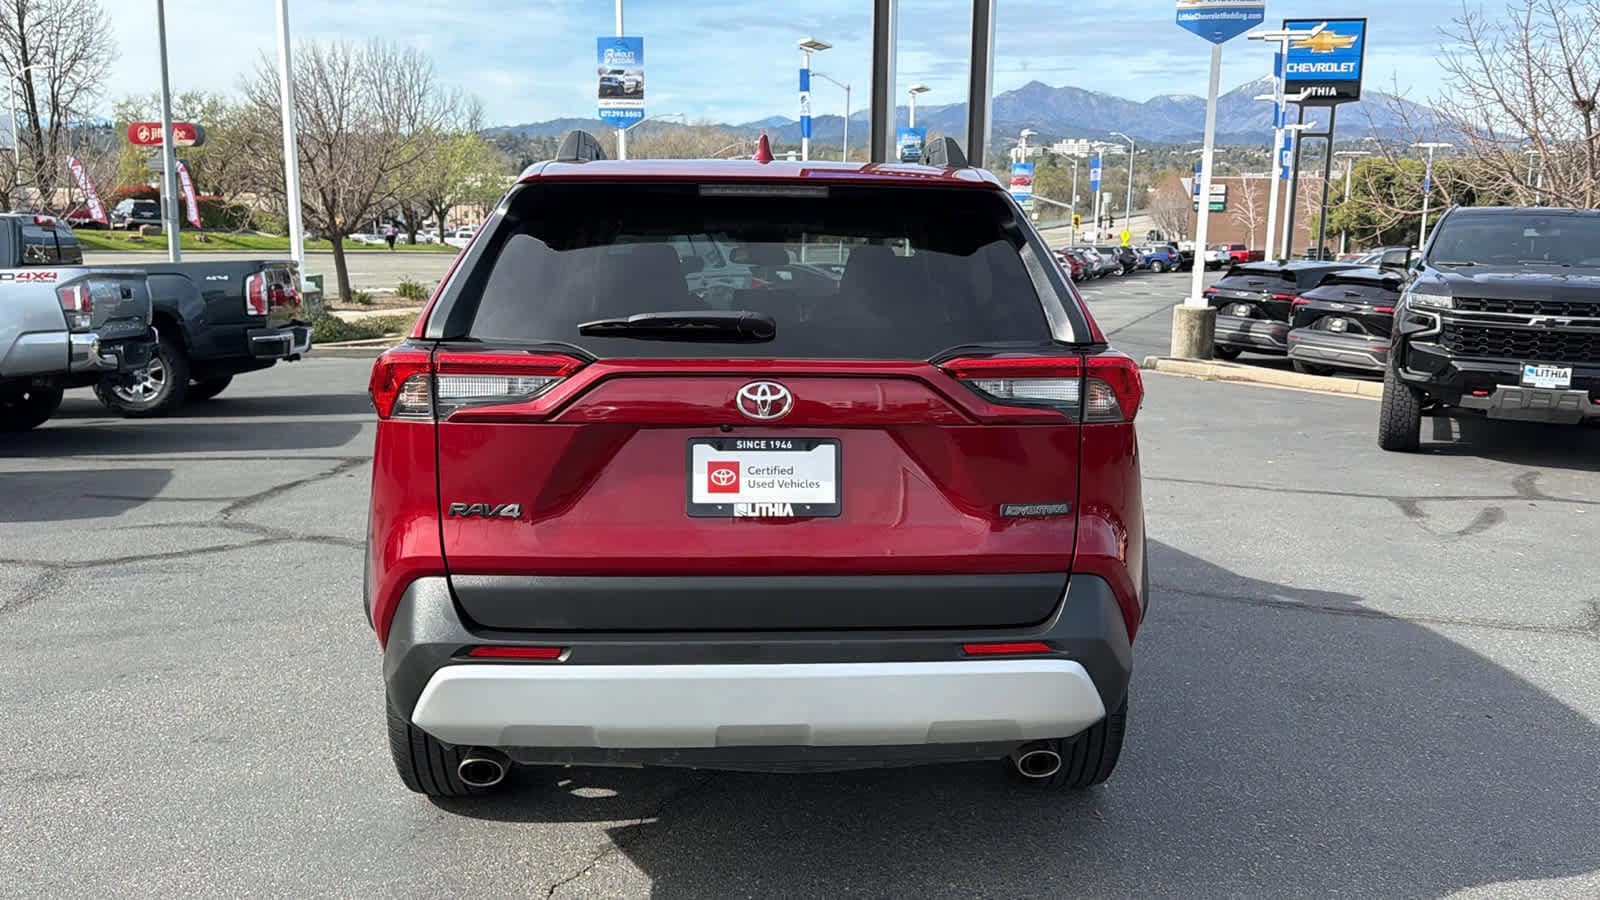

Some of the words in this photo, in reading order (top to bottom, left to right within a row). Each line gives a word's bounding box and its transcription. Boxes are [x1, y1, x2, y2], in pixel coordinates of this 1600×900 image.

[1286, 62, 1356, 73] CHEVROLET
[1300, 86, 1337, 97] LTHIA
[1535, 369, 1568, 379] LITHIA
[736, 440, 766, 449] SINCE
[770, 440, 793, 449] 1946
[747, 465, 794, 476] Certified
[747, 480, 775, 489] Used
[778, 479, 821, 489] Vehicles
[447, 502, 521, 518] RAV4
[750, 503, 794, 517] LITHIA
